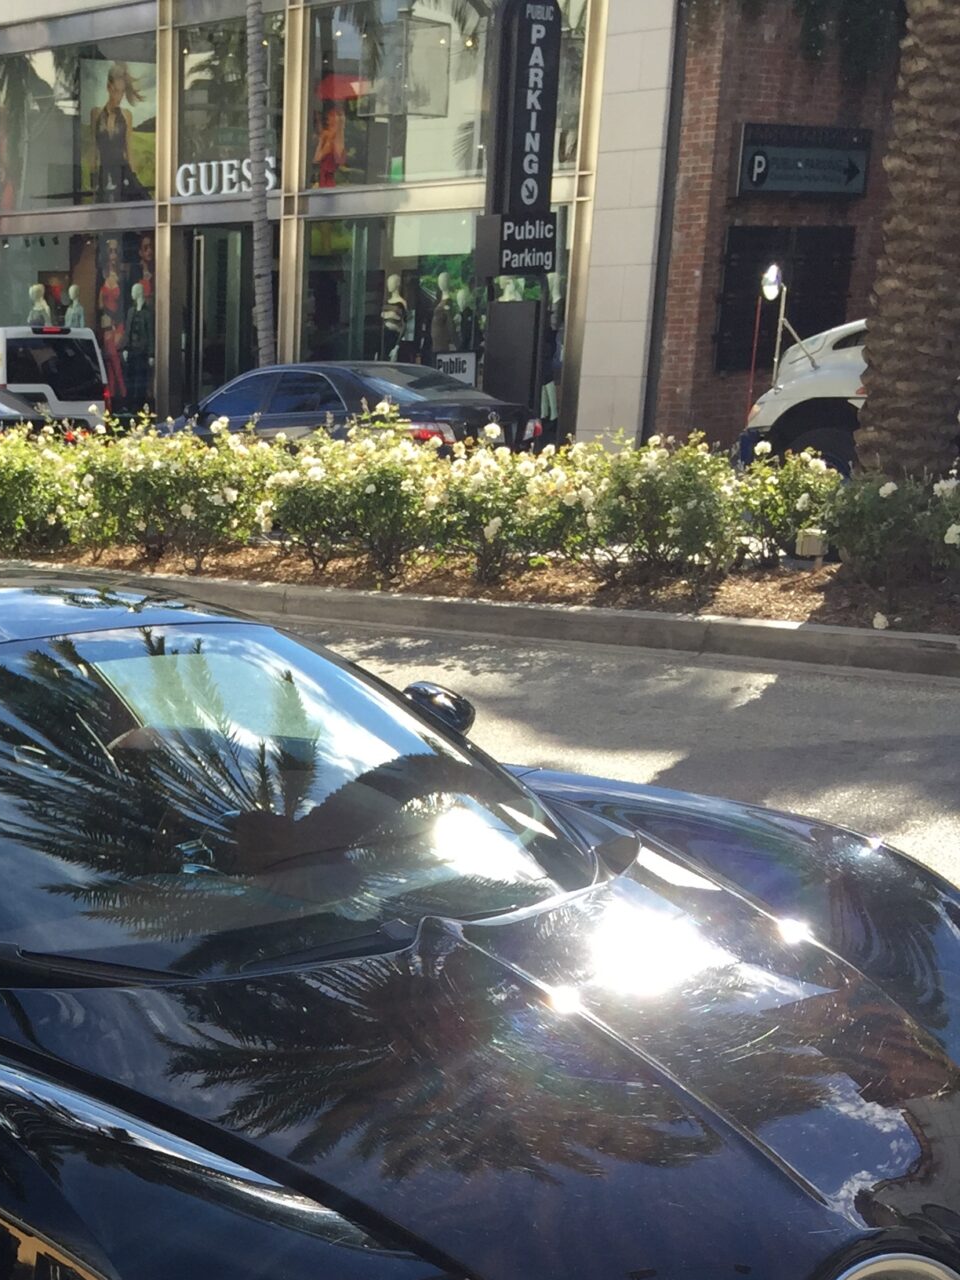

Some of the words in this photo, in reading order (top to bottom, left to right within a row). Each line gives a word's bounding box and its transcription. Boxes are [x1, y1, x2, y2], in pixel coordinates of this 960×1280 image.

[526, 4, 554, 21] PUBLIC
[523, 24, 546, 174] PARKING
[176, 156, 277, 197] GUESS
[503, 220, 554, 241] Public
[502, 249, 553, 270] Parking
[436, 357, 467, 374] Public
